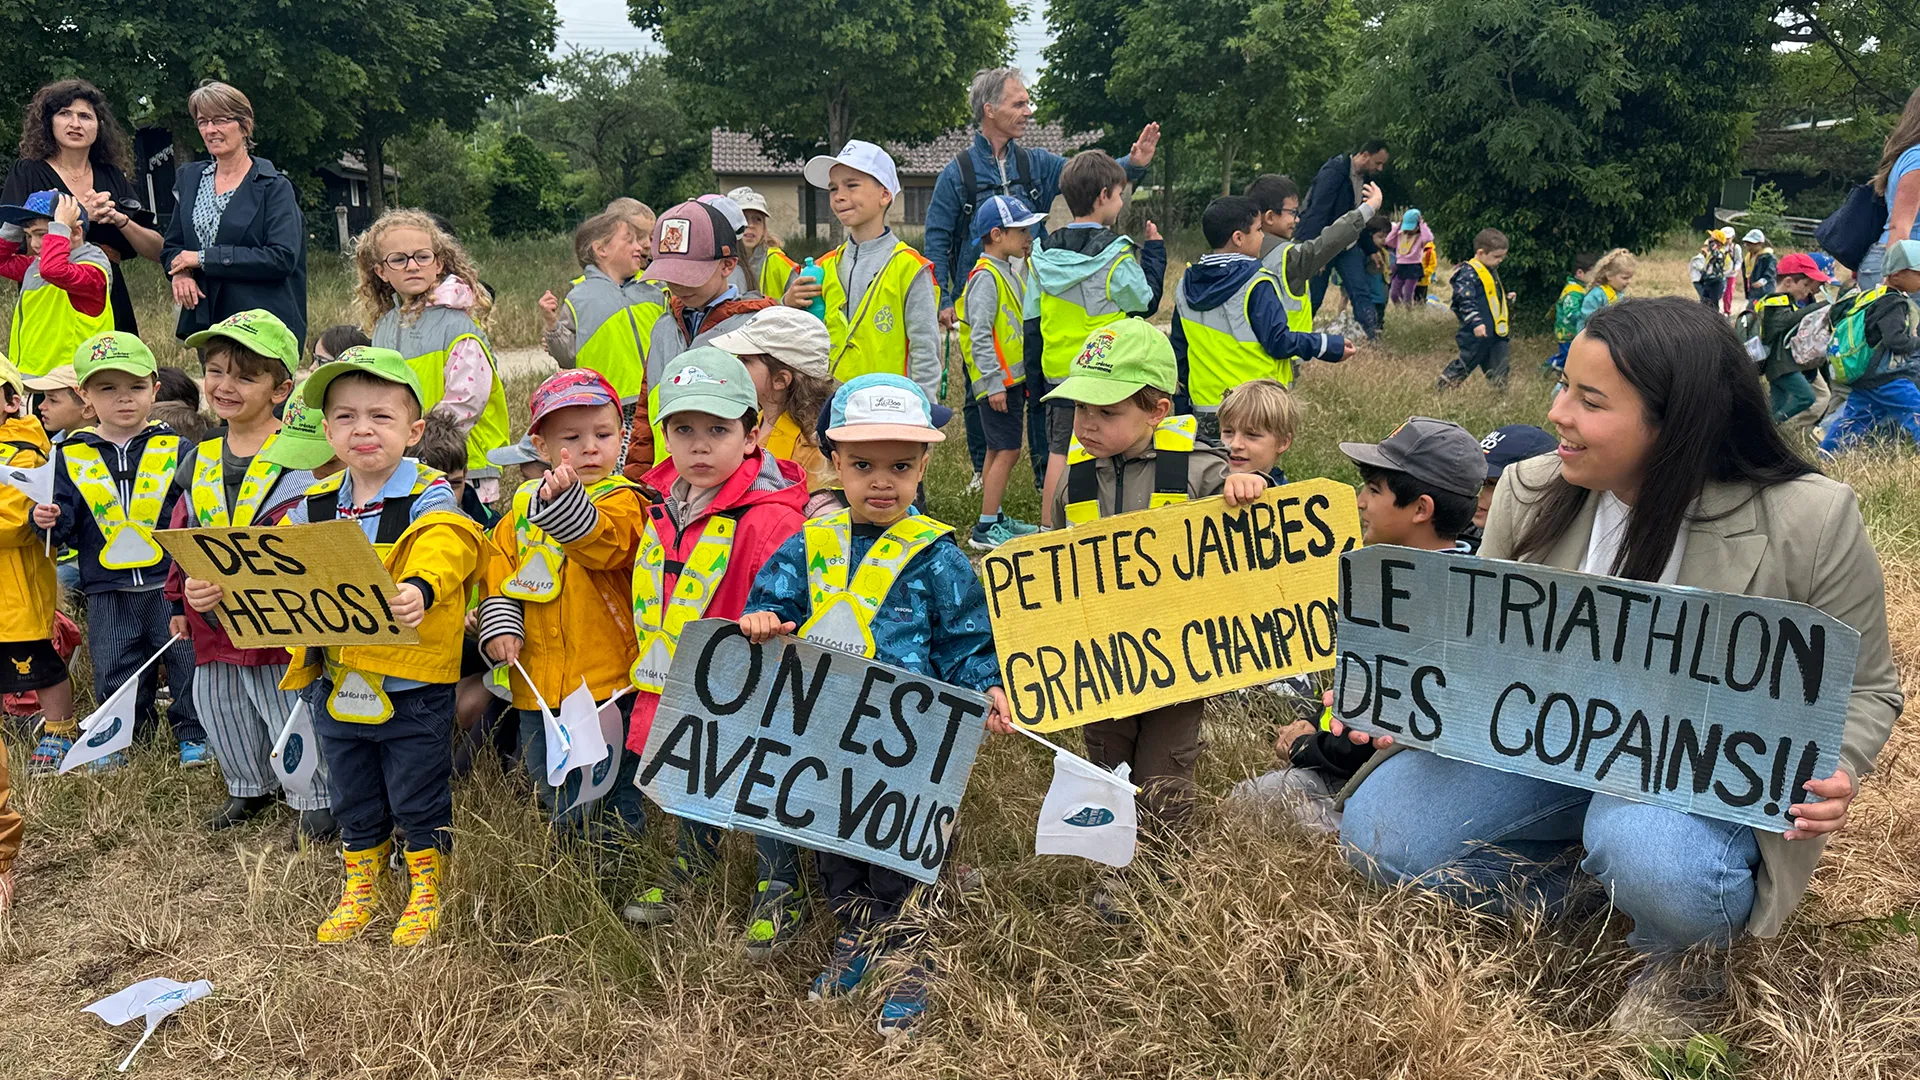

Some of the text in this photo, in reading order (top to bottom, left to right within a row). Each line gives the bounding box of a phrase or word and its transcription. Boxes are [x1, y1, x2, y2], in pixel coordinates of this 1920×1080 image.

[192, 532, 307, 576] DES
[218, 584, 401, 637] HEROS!
[986, 494, 1356, 618] PETITES JAMBES,
[1005, 627, 1176, 726] GRANDS
[1341, 556, 1826, 706] LE TRIATHLON
[694, 623, 985, 785] ON EST
[1337, 651, 1821, 824] DES COPAINS!!
[640, 715, 955, 870] AVEC VOUS
